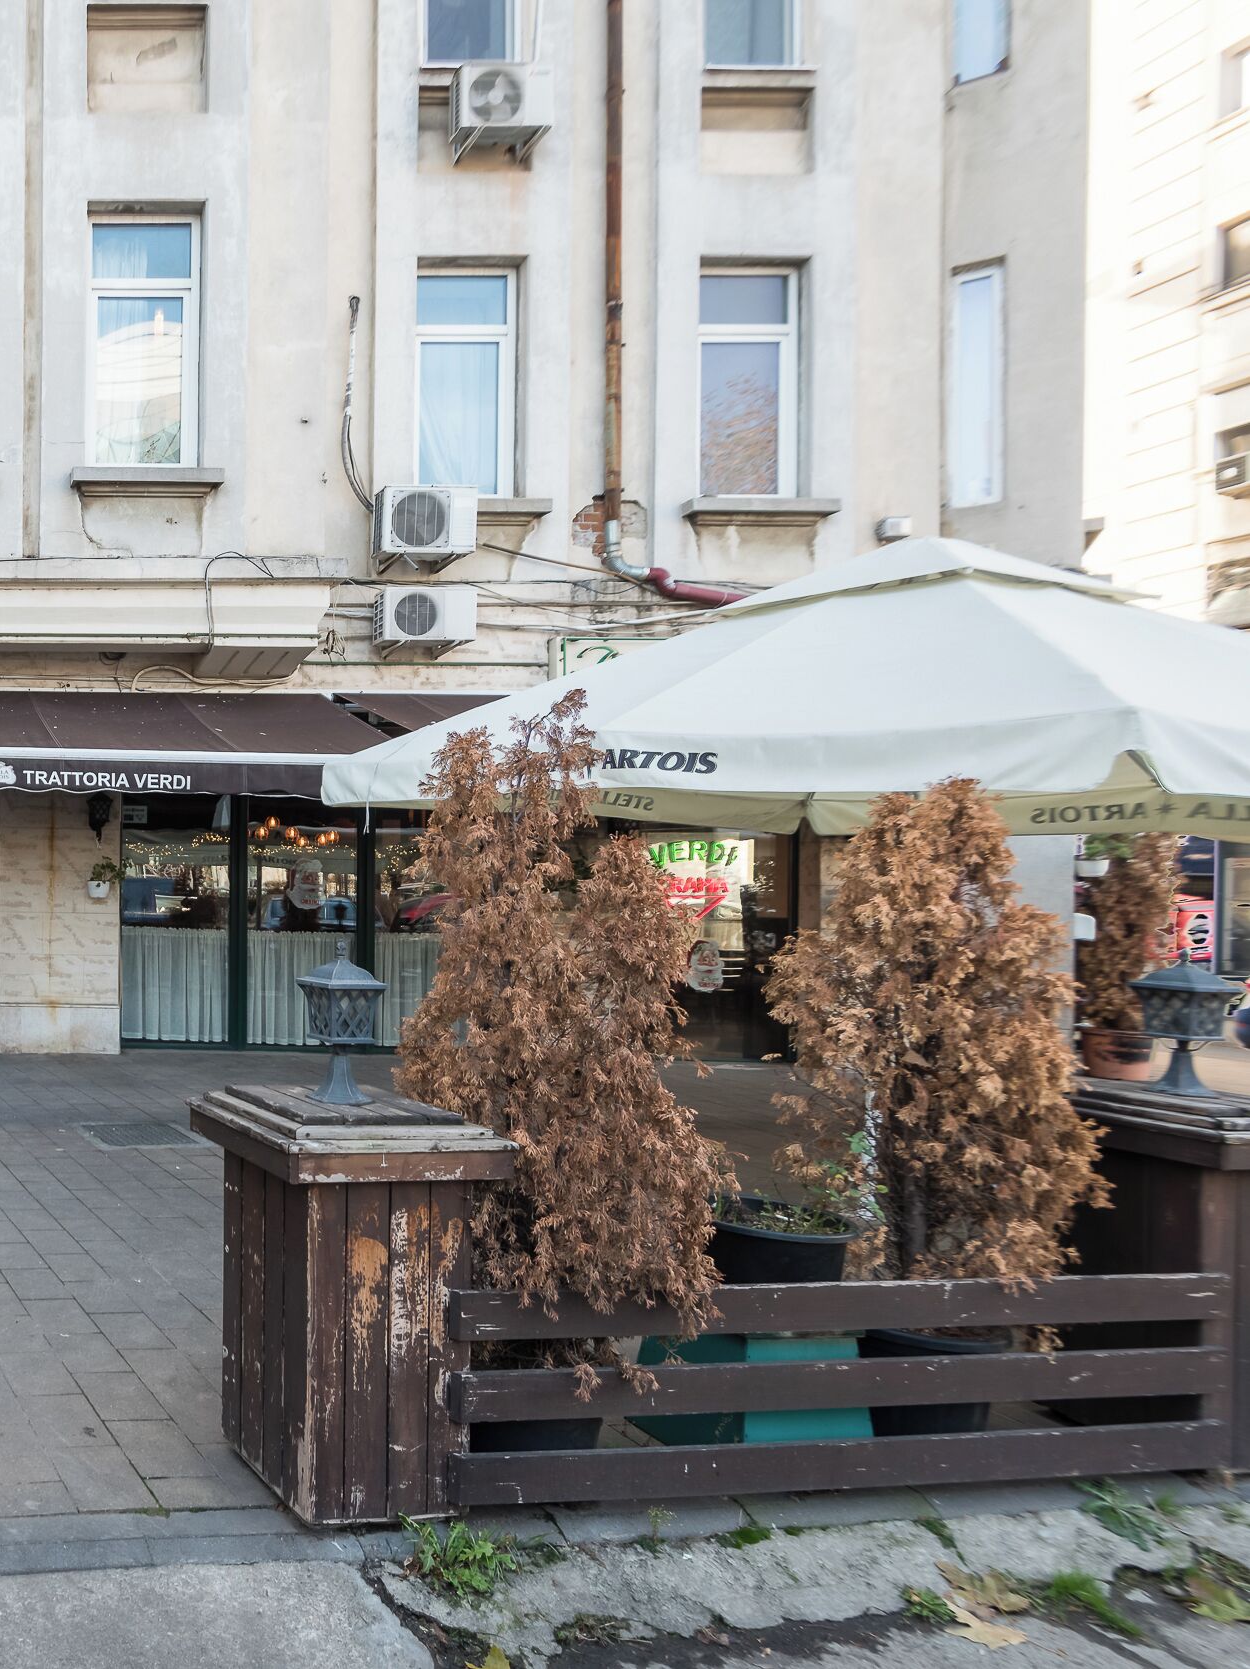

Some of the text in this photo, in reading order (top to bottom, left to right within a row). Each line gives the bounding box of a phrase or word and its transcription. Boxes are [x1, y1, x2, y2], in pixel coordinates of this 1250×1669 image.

[601, 749, 719, 774] ARTOIS
[22, 770, 191, 790] TRATTORIA VERDI
